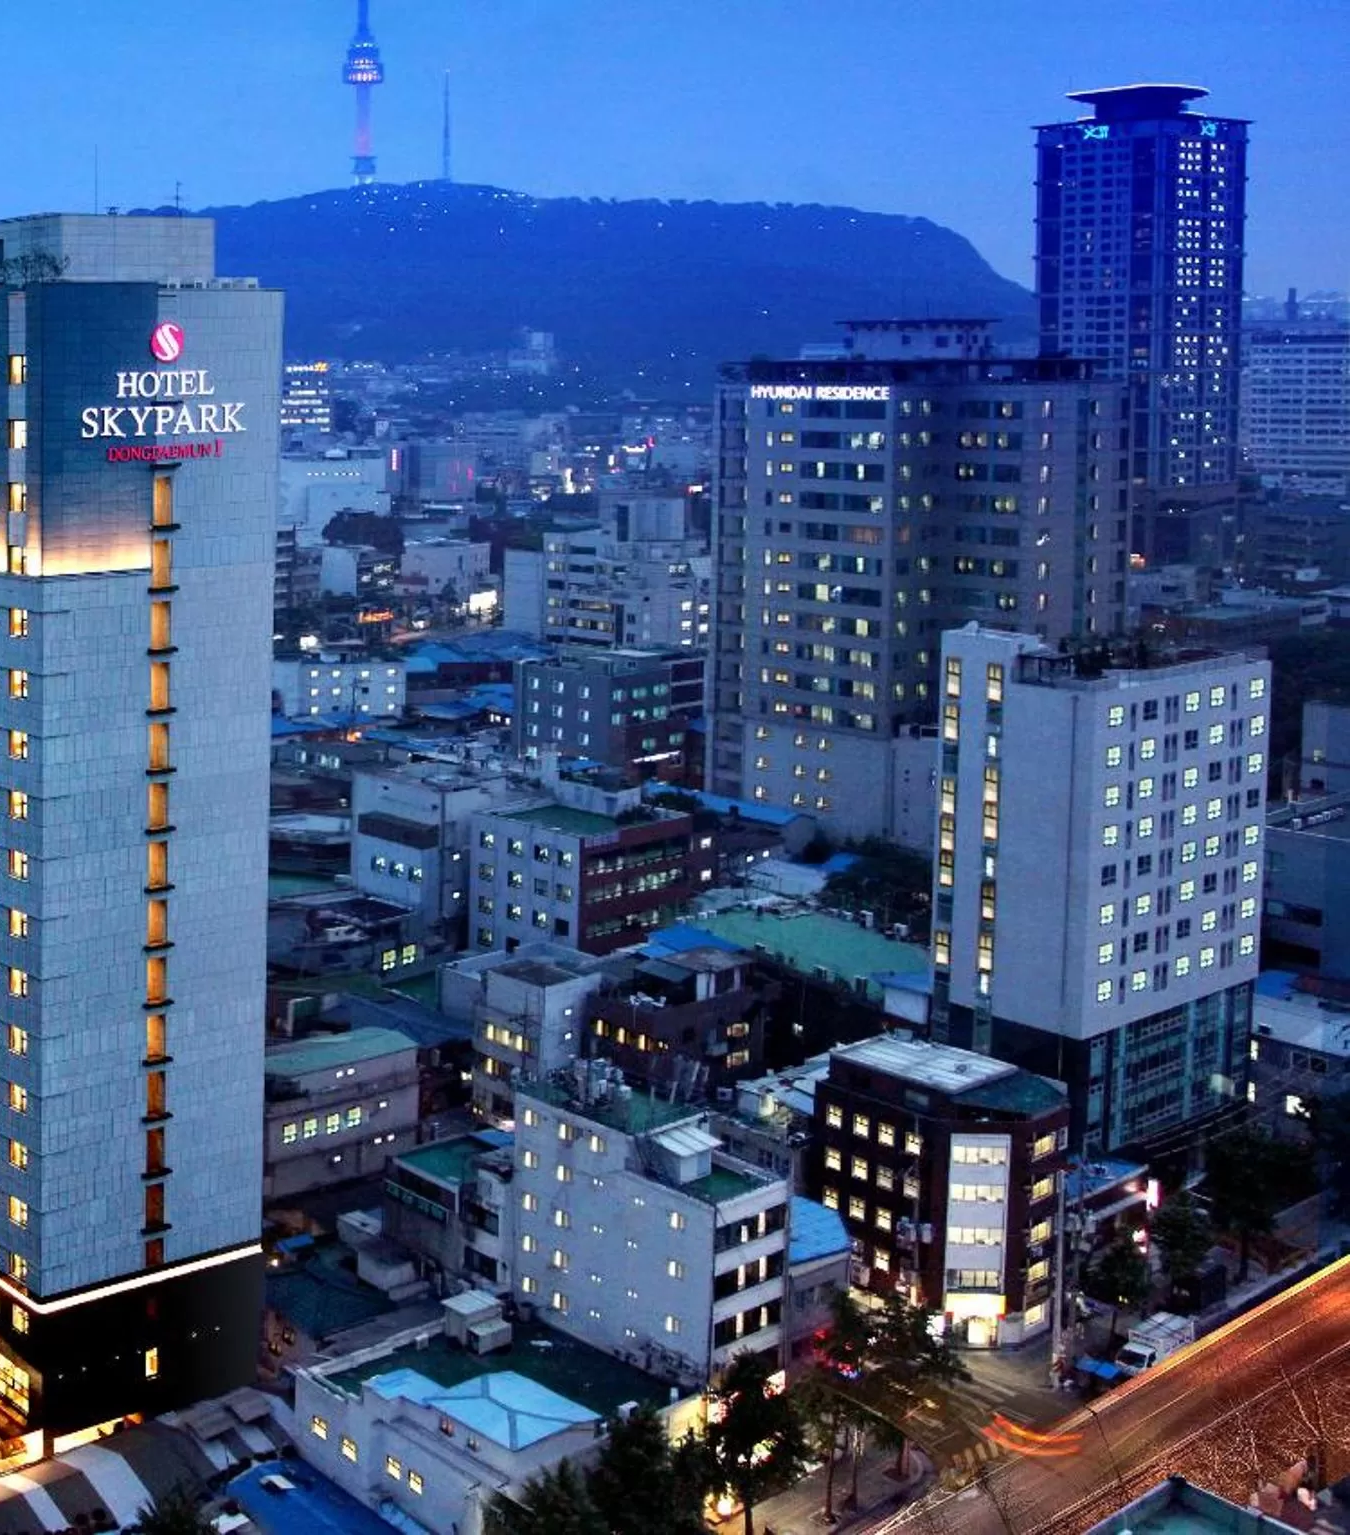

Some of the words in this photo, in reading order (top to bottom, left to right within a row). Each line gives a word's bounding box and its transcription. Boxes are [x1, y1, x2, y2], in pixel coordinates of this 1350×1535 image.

[115, 370, 215, 399] HOTEL
[751, 385, 812, 400] HYUNDAI
[815, 386, 890, 400] RESIDENCE
[81, 402, 247, 438] SKYPARK
[107, 443, 212, 462] DONGDAEMUN
